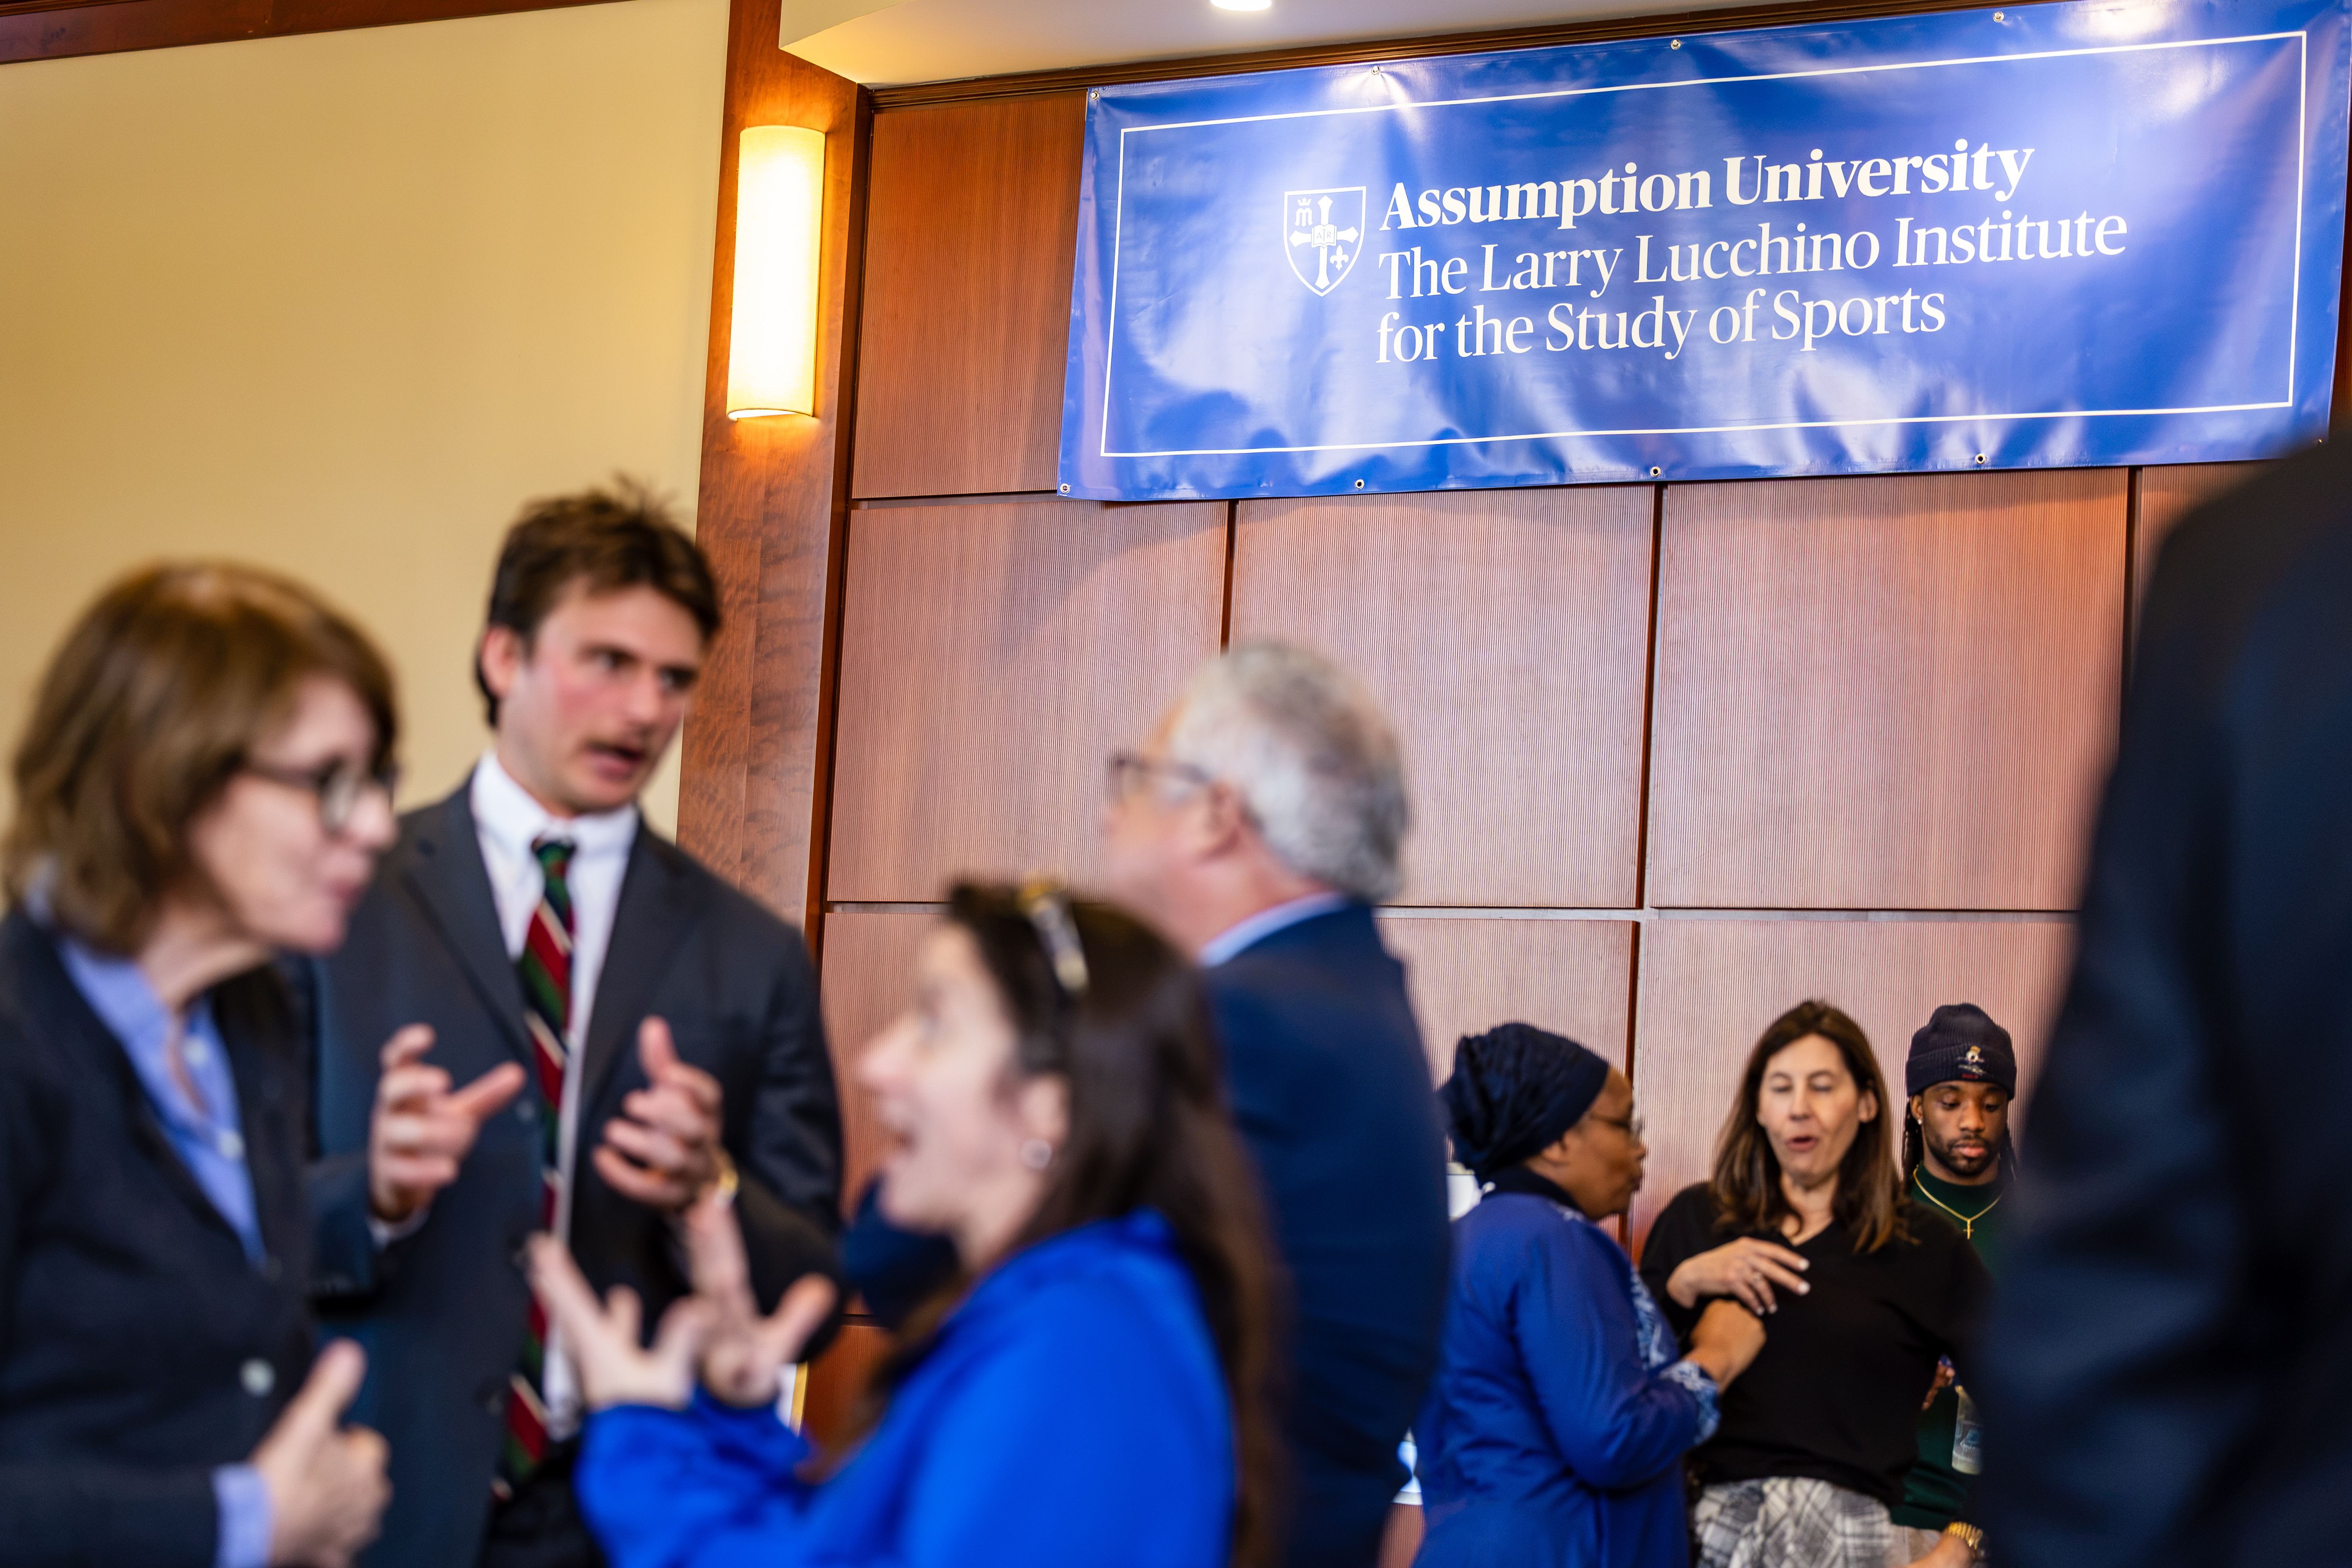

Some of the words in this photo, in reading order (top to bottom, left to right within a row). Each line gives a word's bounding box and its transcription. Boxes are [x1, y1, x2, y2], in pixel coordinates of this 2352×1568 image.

[1379, 162, 1713, 231] Assumption
[1723, 138, 2035, 205] University
[1378, 246, 1468, 300] The
[1479, 244, 1624, 298] Larry
[1633, 222, 1880, 283] Lucchino
[1892, 209, 2127, 267] Institute
[1375, 311, 1446, 363] for
[1455, 304, 1534, 358] the
[1546, 295, 1698, 360] Study
[1709, 288, 1767, 344] of
[1771, 287, 1946, 352] Sports
